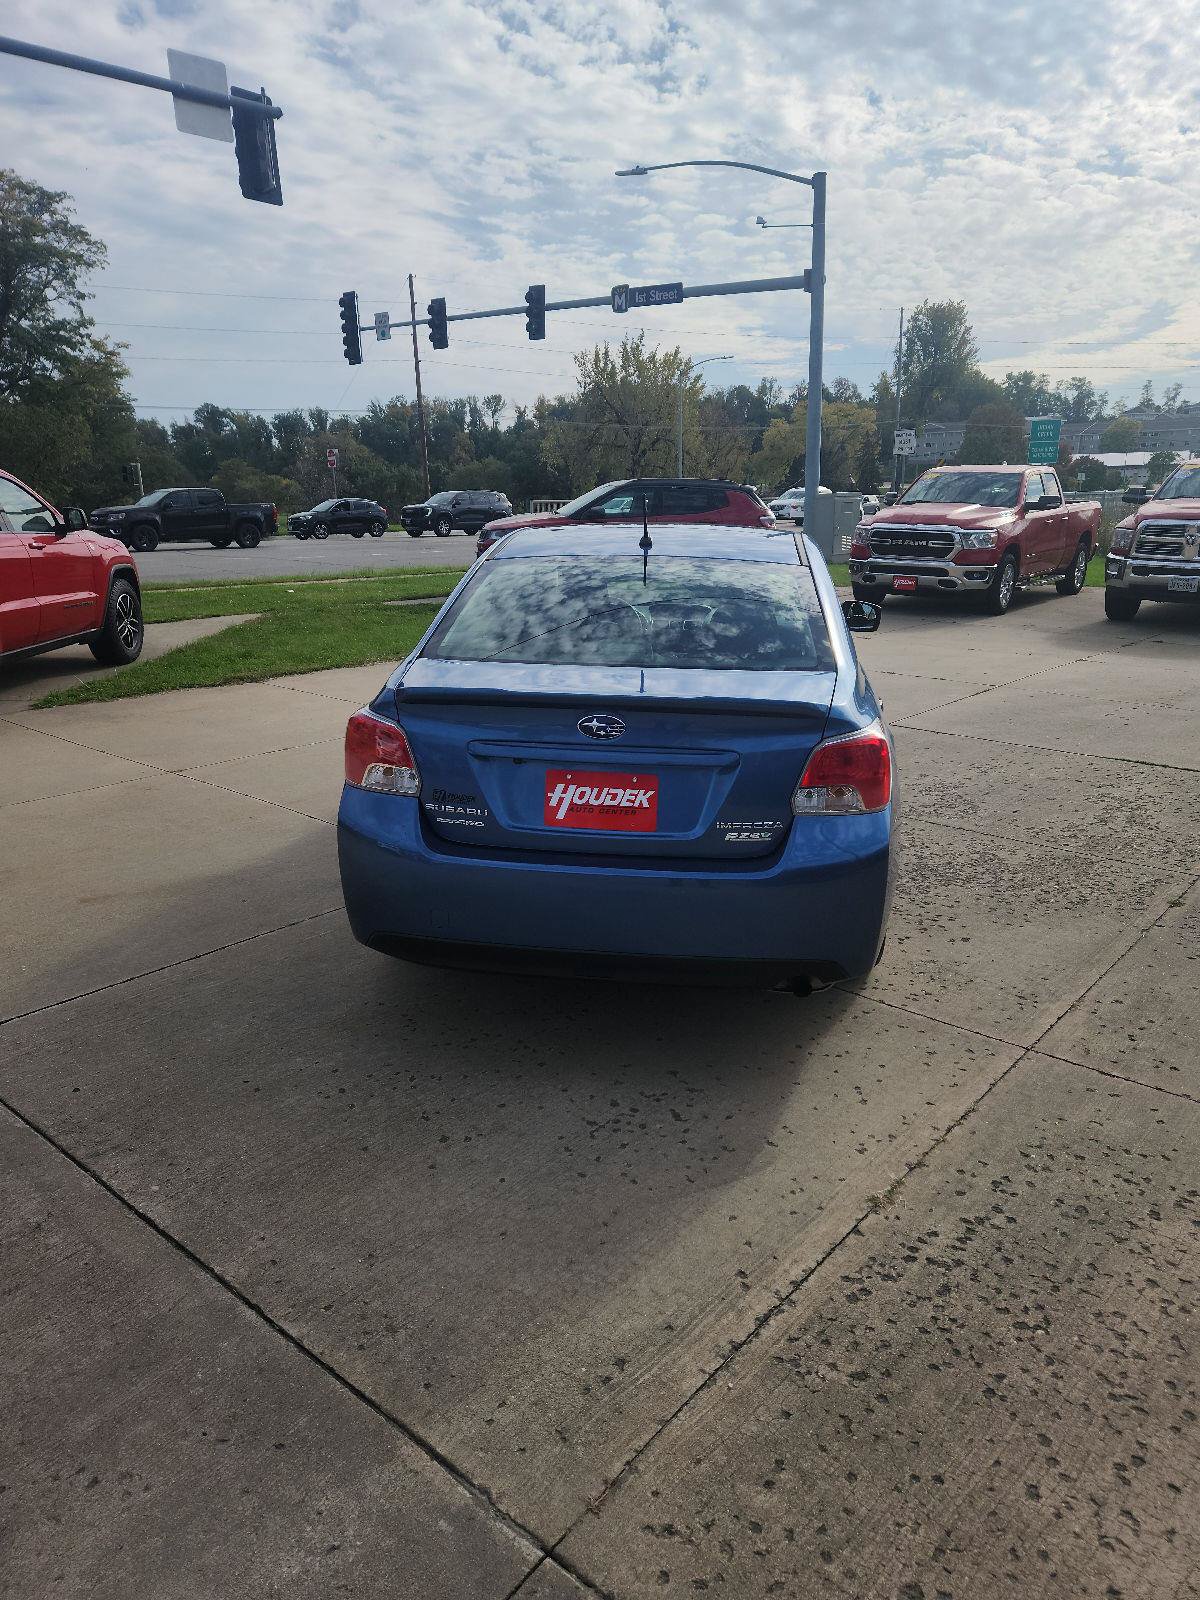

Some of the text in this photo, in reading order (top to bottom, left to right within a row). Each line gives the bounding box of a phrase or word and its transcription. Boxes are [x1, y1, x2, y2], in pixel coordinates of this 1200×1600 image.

[649, 288, 678, 301] Street
[547, 783, 656, 820] HOUDEK
[425, 803, 488, 816] SUBARU
[569, 806, 638, 816] AUTO CENTER
[716, 821, 784, 829] IMPREZA
